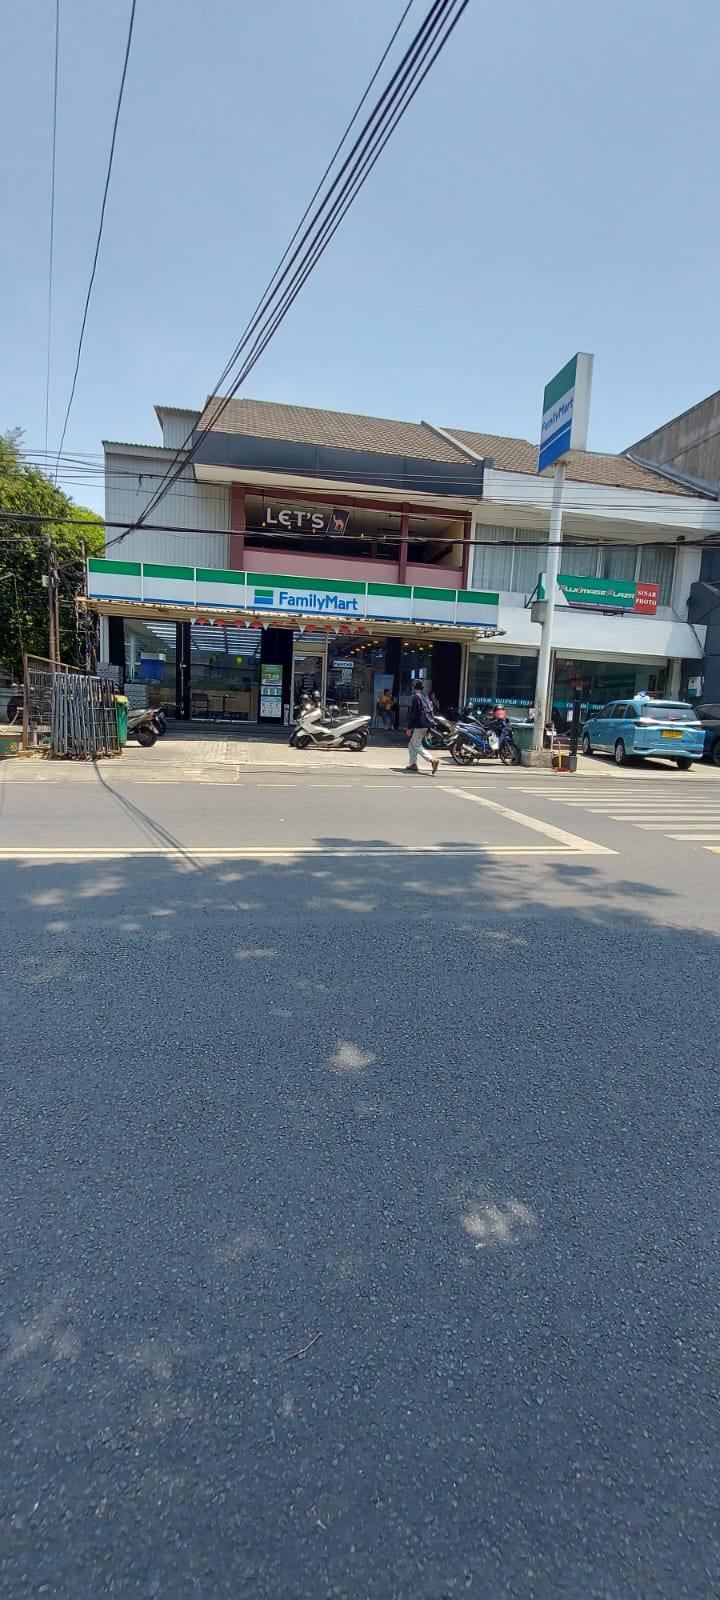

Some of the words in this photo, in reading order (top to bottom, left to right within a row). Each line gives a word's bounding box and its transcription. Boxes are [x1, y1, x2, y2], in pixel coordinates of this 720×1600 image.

[541, 397, 574, 433] FamilyMart
[279, 591, 358, 611] FamilyMart
[638, 590, 657, 598] SINAR
[635, 598, 657, 606] PHOTO
